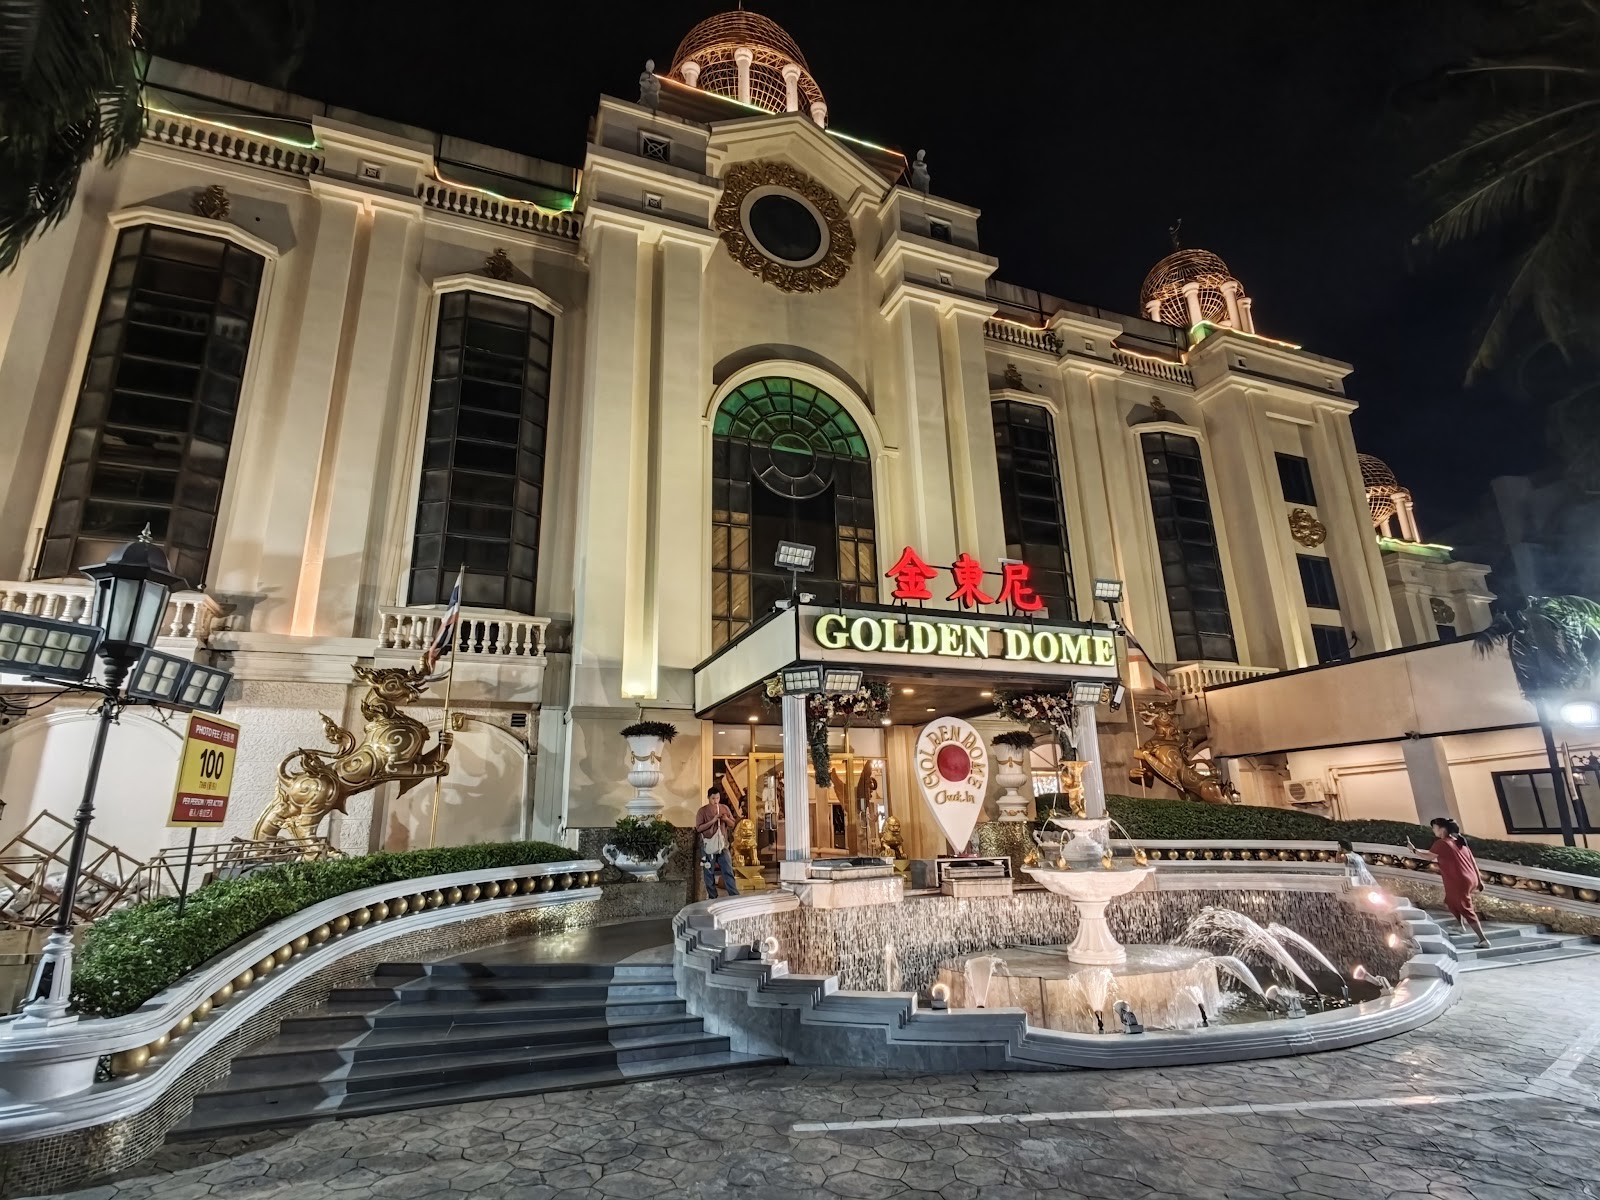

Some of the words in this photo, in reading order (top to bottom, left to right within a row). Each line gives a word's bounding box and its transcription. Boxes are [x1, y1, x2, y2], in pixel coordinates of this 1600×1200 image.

[885, 546, 1043, 611] 金東尼
[816, 613, 989, 658] GOLDEN
[1003, 627, 1116, 667] DOME
[196, 725, 212, 737] PHOTO
[212, 729, 221, 739] FEE
[200, 748, 224, 779] 100
[920, 725, 961, 789] GOLDEN
[961, 731, 985, 789] DOME
[182, 797, 190, 805] PER
[190, 797, 205, 806] PERSON
